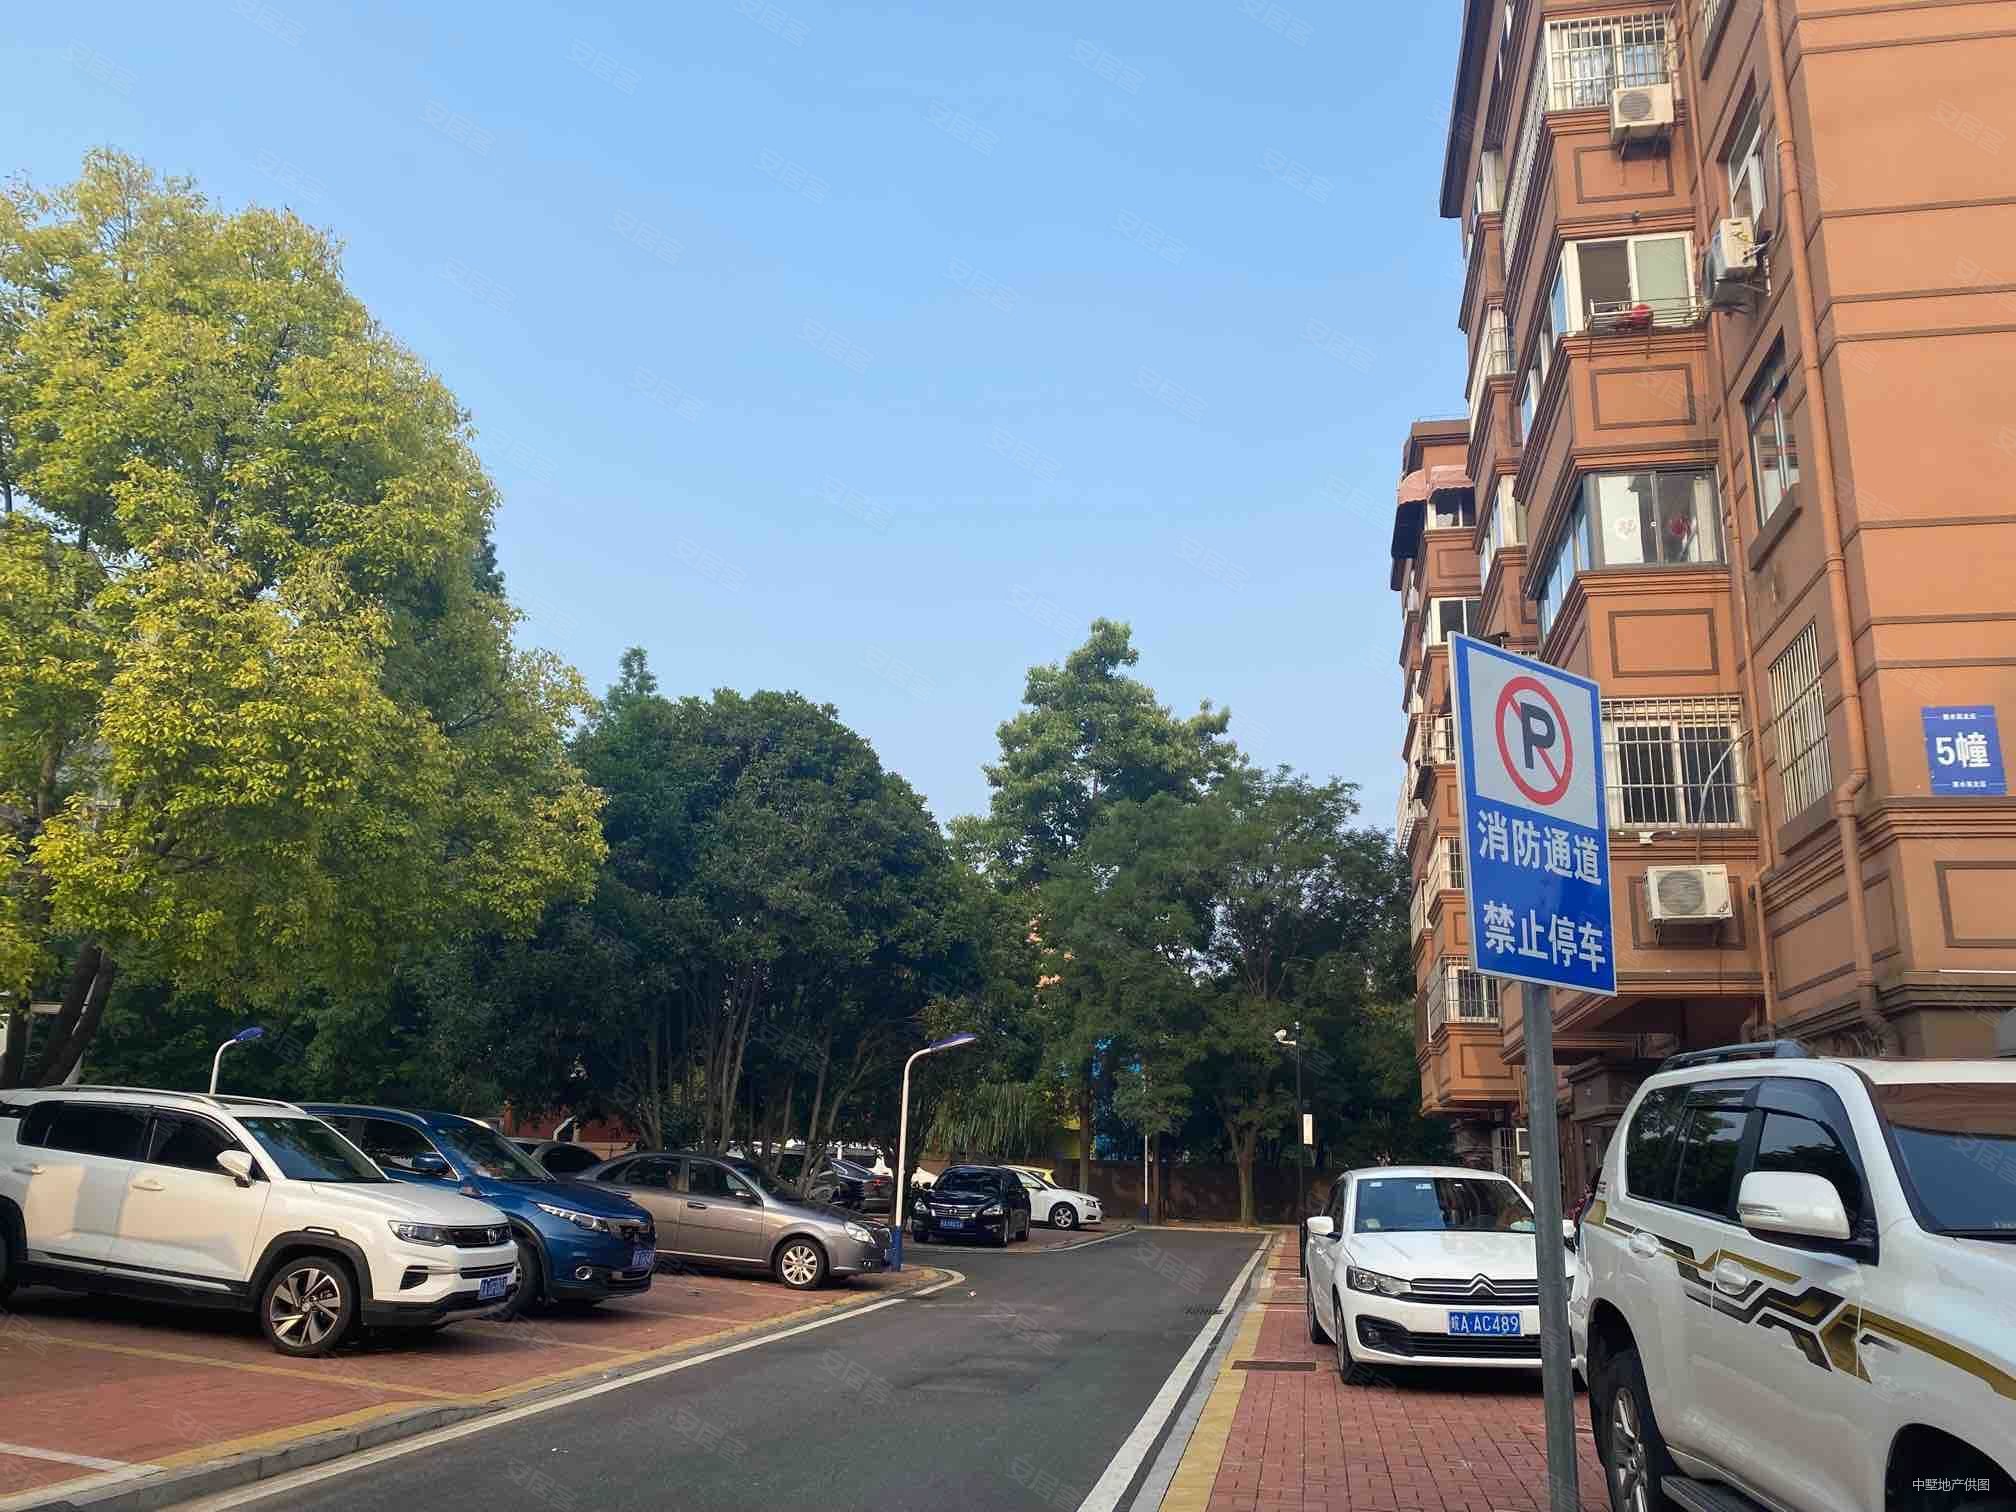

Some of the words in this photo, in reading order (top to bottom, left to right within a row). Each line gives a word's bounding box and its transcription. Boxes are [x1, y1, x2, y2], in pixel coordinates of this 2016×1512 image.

[1936, 731, 1991, 768] 5幢
[1477, 810, 1601, 885] 消防通道
[1483, 900, 1606, 973] 禁止停车
